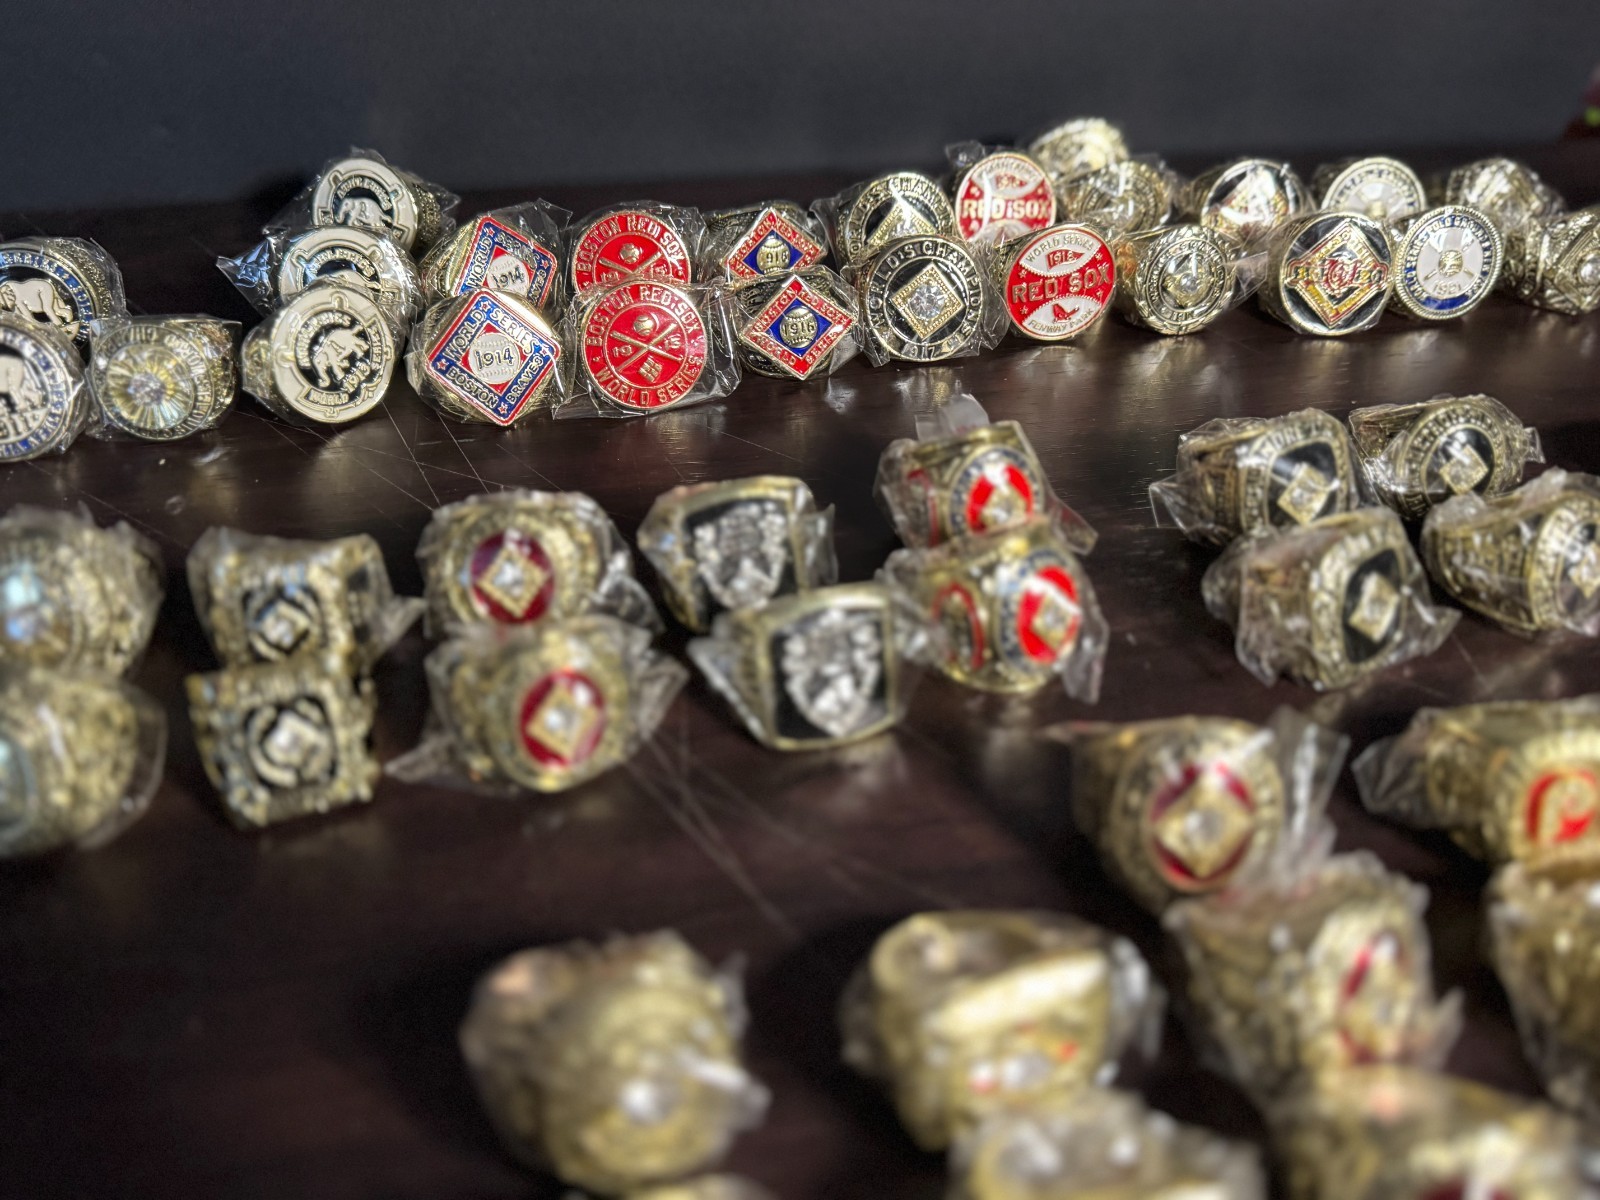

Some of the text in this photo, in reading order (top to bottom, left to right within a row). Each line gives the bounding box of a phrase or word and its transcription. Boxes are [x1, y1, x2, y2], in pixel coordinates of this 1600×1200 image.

[1012, 199, 1049, 220] SOX
[577, 217, 622, 272] BOSTON
[626, 215, 686, 264] RED SOX
[1025, 232, 1095, 264] WORLD SERIES
[1047, 250, 1076, 267] 1918
[465, 236, 493, 289] WORLD
[492, 264, 526, 288] 1914
[1011, 262, 1111, 304] RED SOX
[441, 308, 543, 364] WORLD SERIES
[586, 284, 701, 347] BOSTON RED SOX
[781, 322, 816, 338] 1916
[1027, 318, 1068, 333] FENWAY
[474, 346, 515, 370] 1914
[446, 354, 545, 409] BOSTON BRAVES
[595, 353, 705, 406] WORLD SERIES
